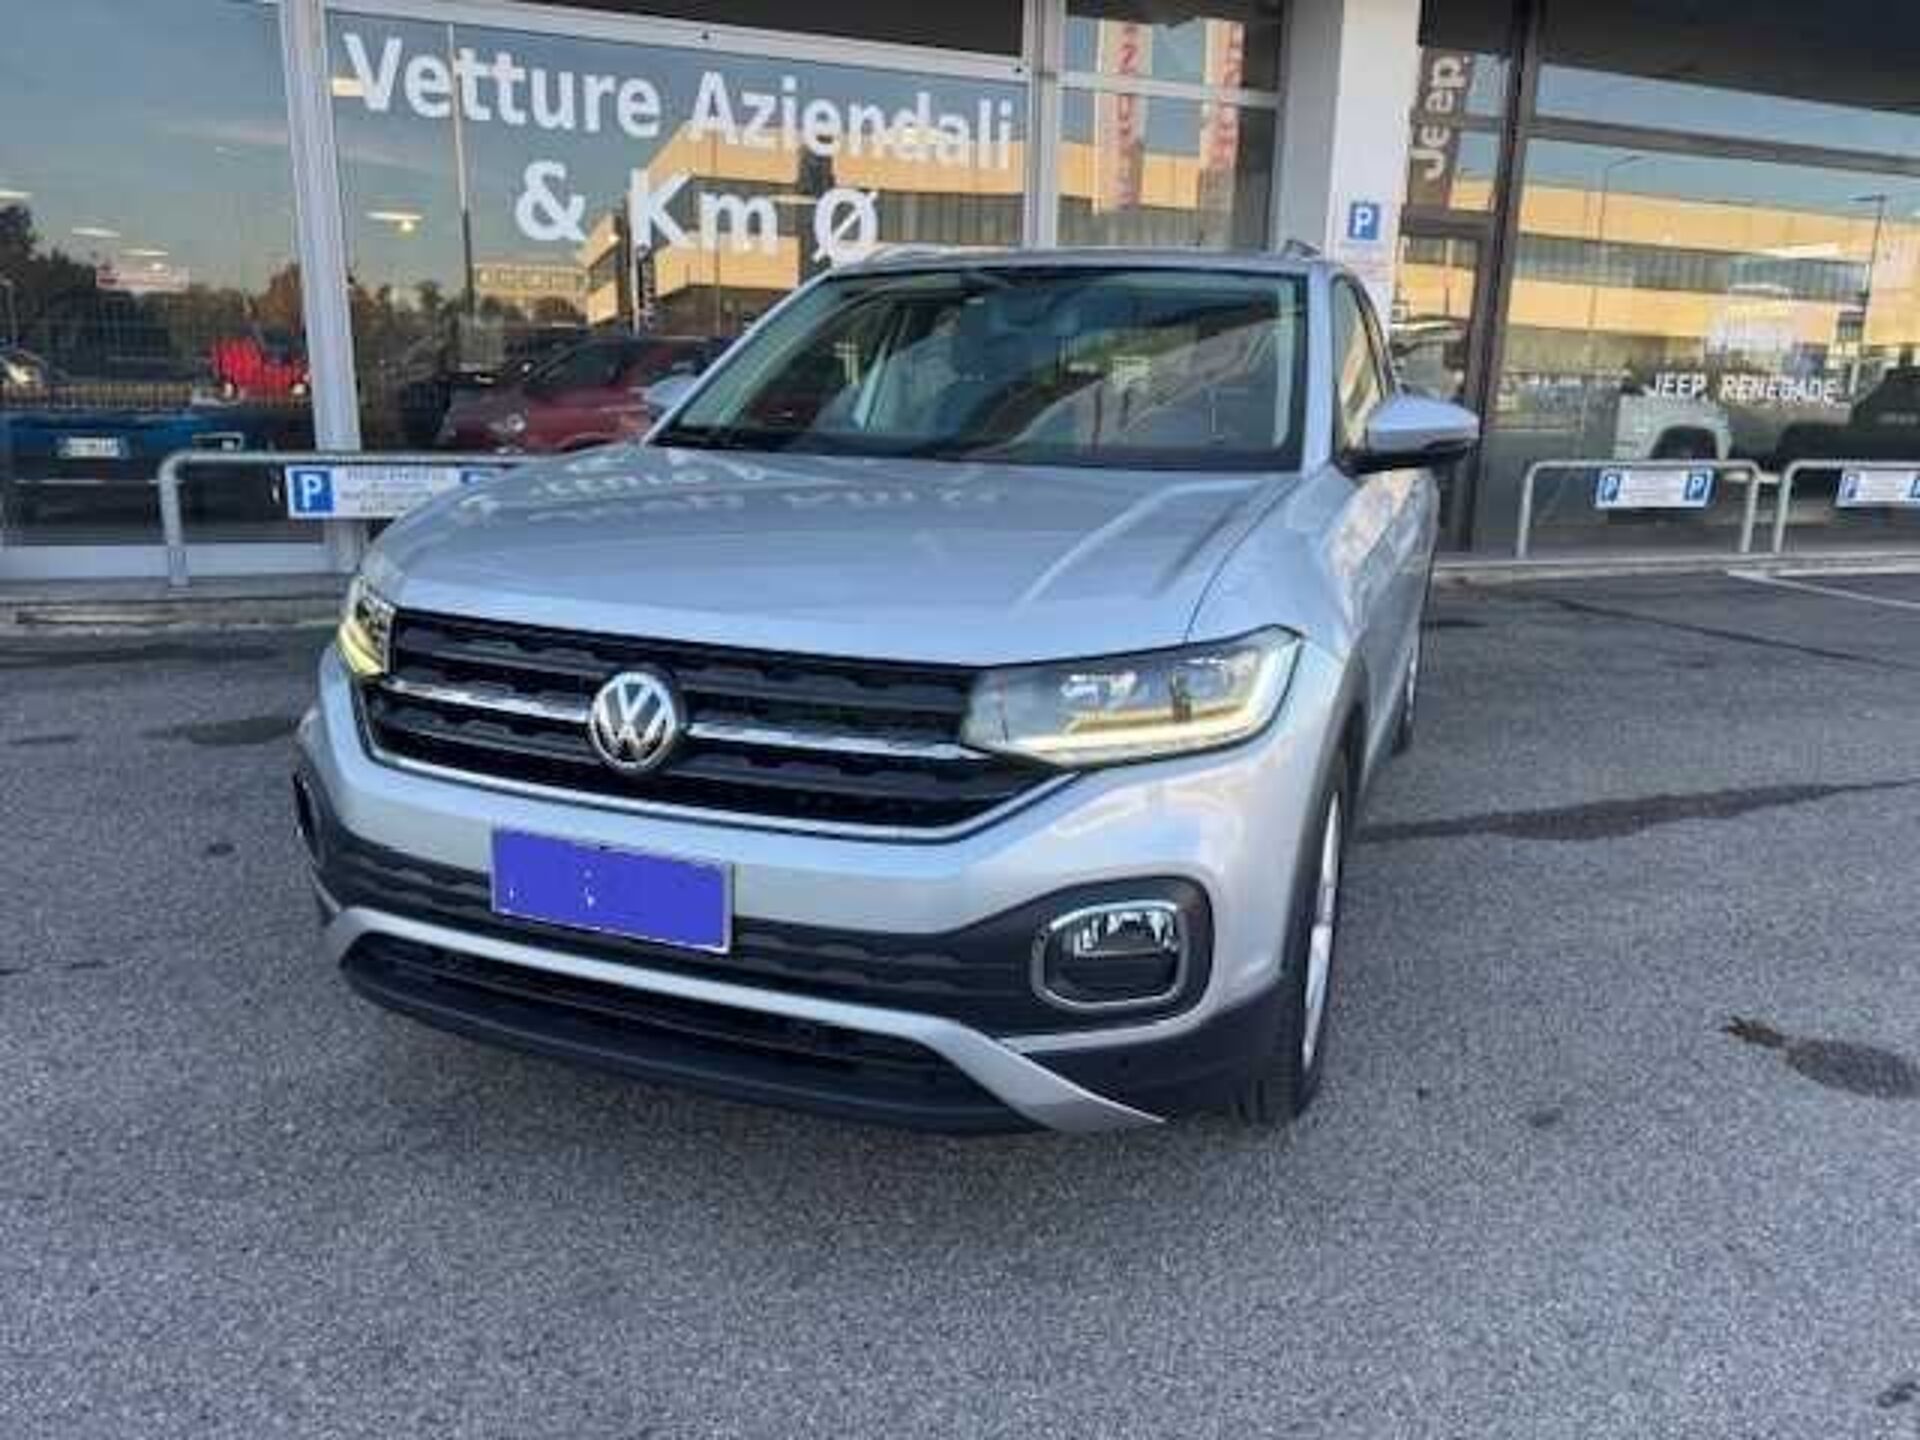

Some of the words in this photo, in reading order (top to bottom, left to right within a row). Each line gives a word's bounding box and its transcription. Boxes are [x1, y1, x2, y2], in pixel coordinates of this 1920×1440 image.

[344, 33, 661, 135] Vetture
[690, 71, 1014, 170] Aziendali
[515, 160, 586, 243] &
[629, 168, 778, 254] Km
[1353, 206, 1373, 235] P
[1650, 371, 1707, 398] JEEP
[1719, 374, 1840, 403] RENEGADE
[302, 473, 322, 508] P
